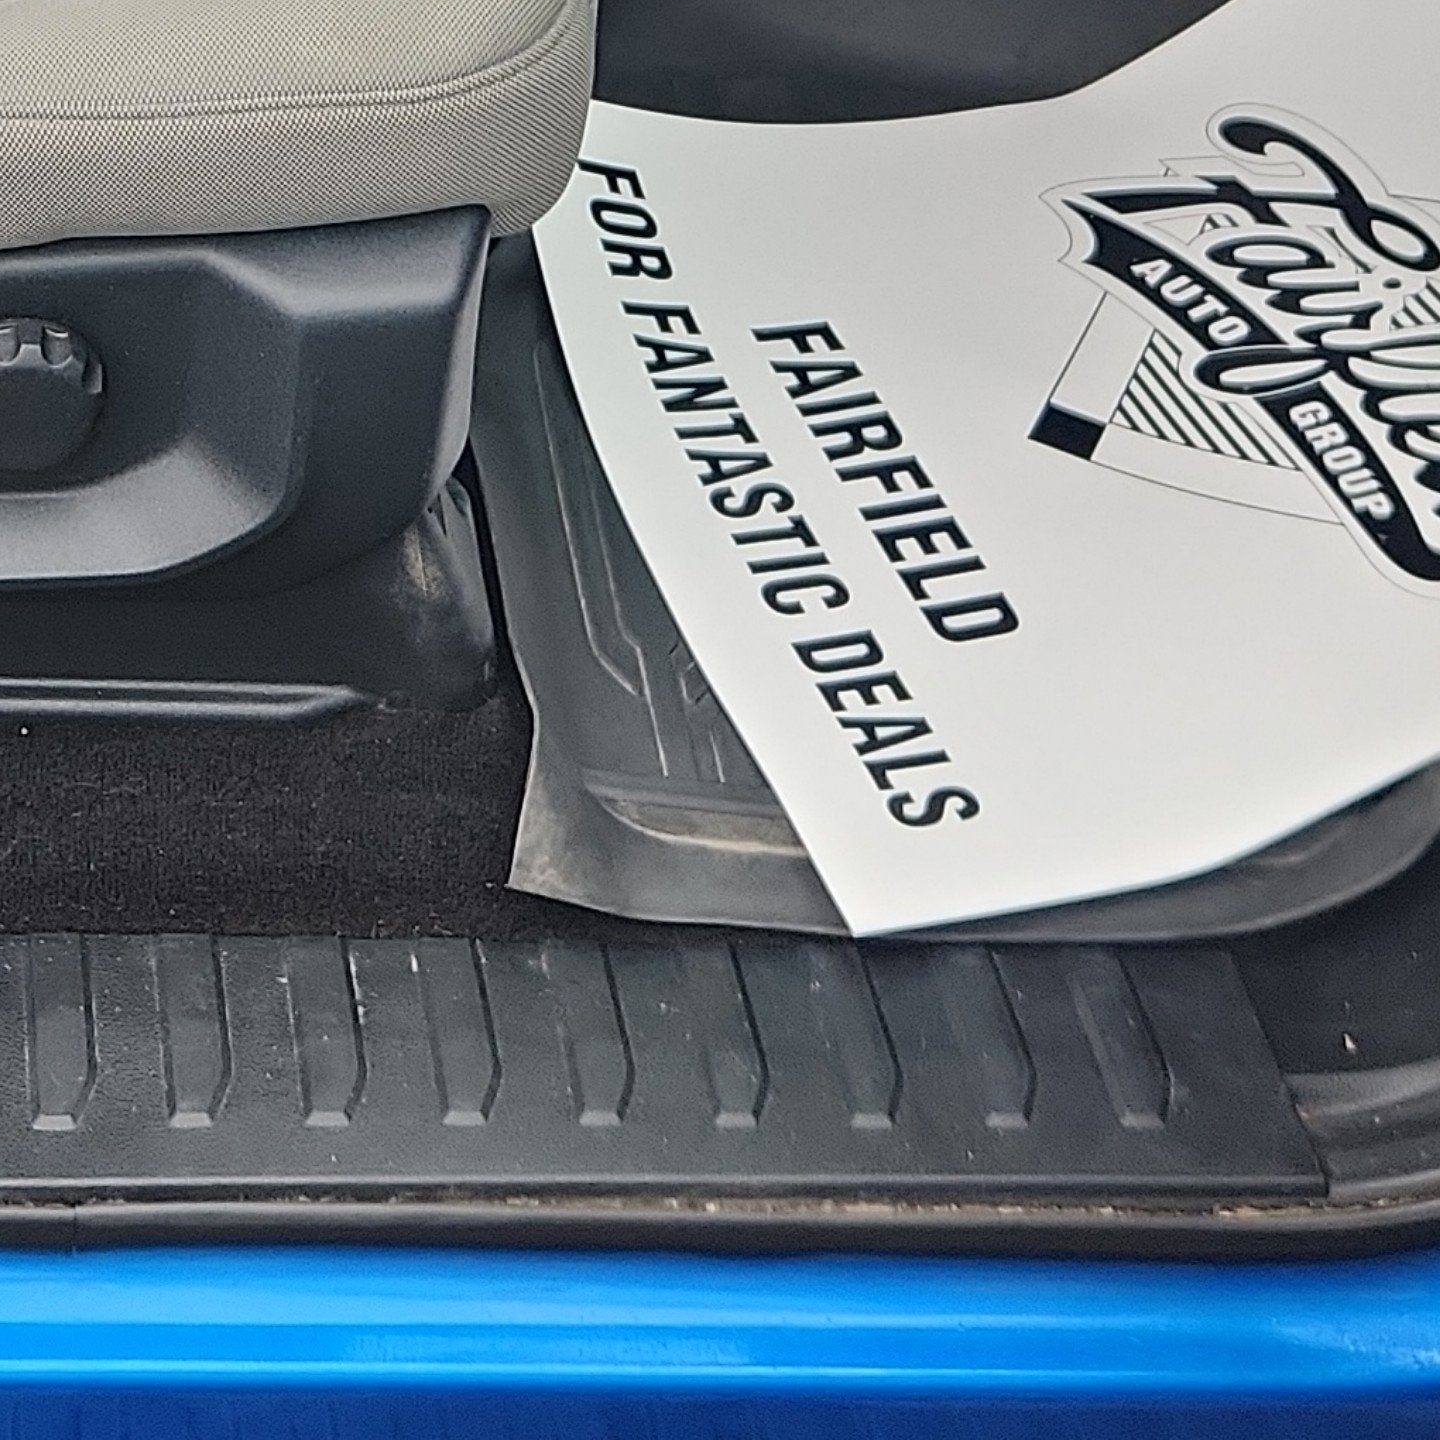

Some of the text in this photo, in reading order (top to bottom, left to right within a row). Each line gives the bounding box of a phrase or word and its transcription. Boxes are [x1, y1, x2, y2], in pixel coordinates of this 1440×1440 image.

[1128, 256, 1250, 345] AUTO
[576, 157, 982, 829] FOR FANTASTIC DEALS
[749, 319, 1020, 644] FAIRFIELD
[1287, 399, 1397, 523] GROUP
